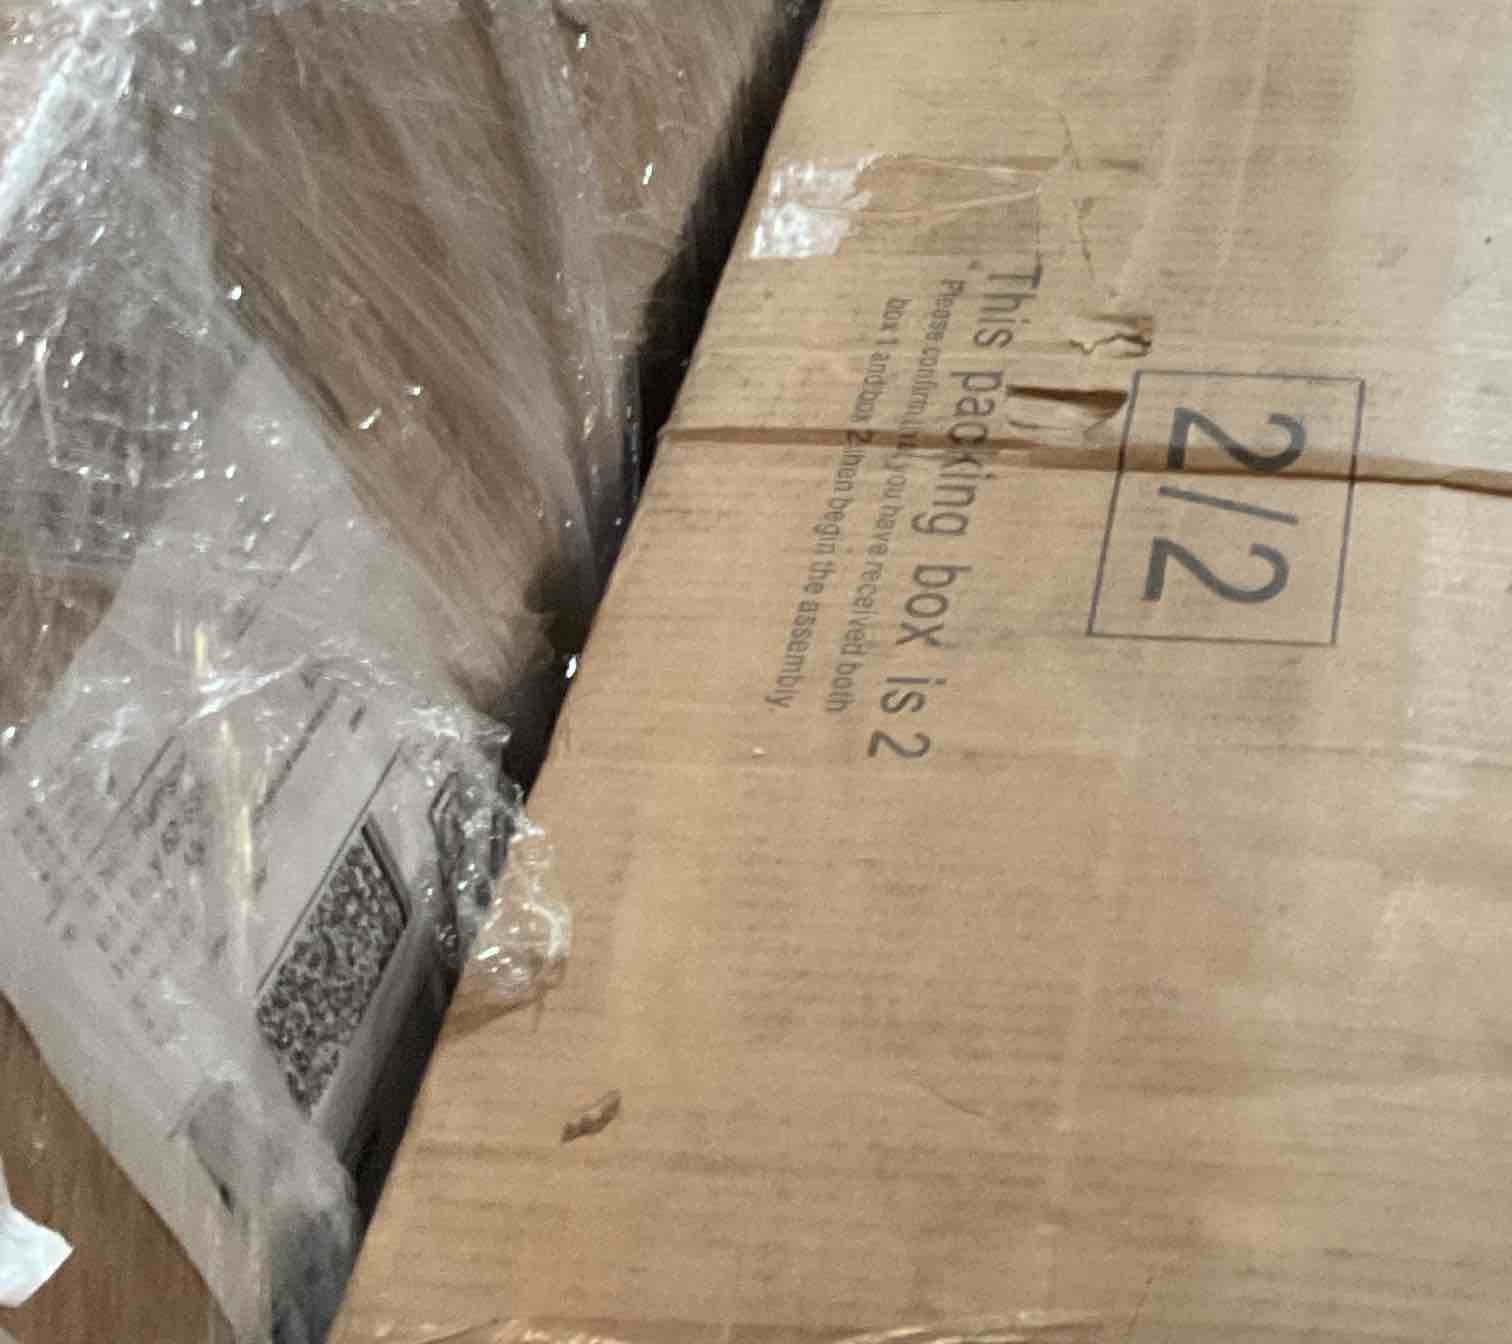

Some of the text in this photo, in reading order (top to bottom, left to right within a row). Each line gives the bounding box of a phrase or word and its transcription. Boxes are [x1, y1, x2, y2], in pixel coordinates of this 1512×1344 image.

[879, 297, 913, 333] box
[929, 278, 966, 341] Please
[874, 336, 899, 347] 1
[862, 352, 891, 387] and
[906, 347, 946, 417] confirm
[850, 389, 887, 423] box
[883, 463, 914, 500] you
[1140, 405, 1309, 605] 2/2
[813, 498, 851, 555] begin
[867, 265, 1044, 760] This packing box is 2
[869, 505, 906, 556] have
[802, 560, 840, 595] the
[840, 560, 889, 656] received
[765, 599, 820, 714] assembly.
[825, 662, 865, 713] both
